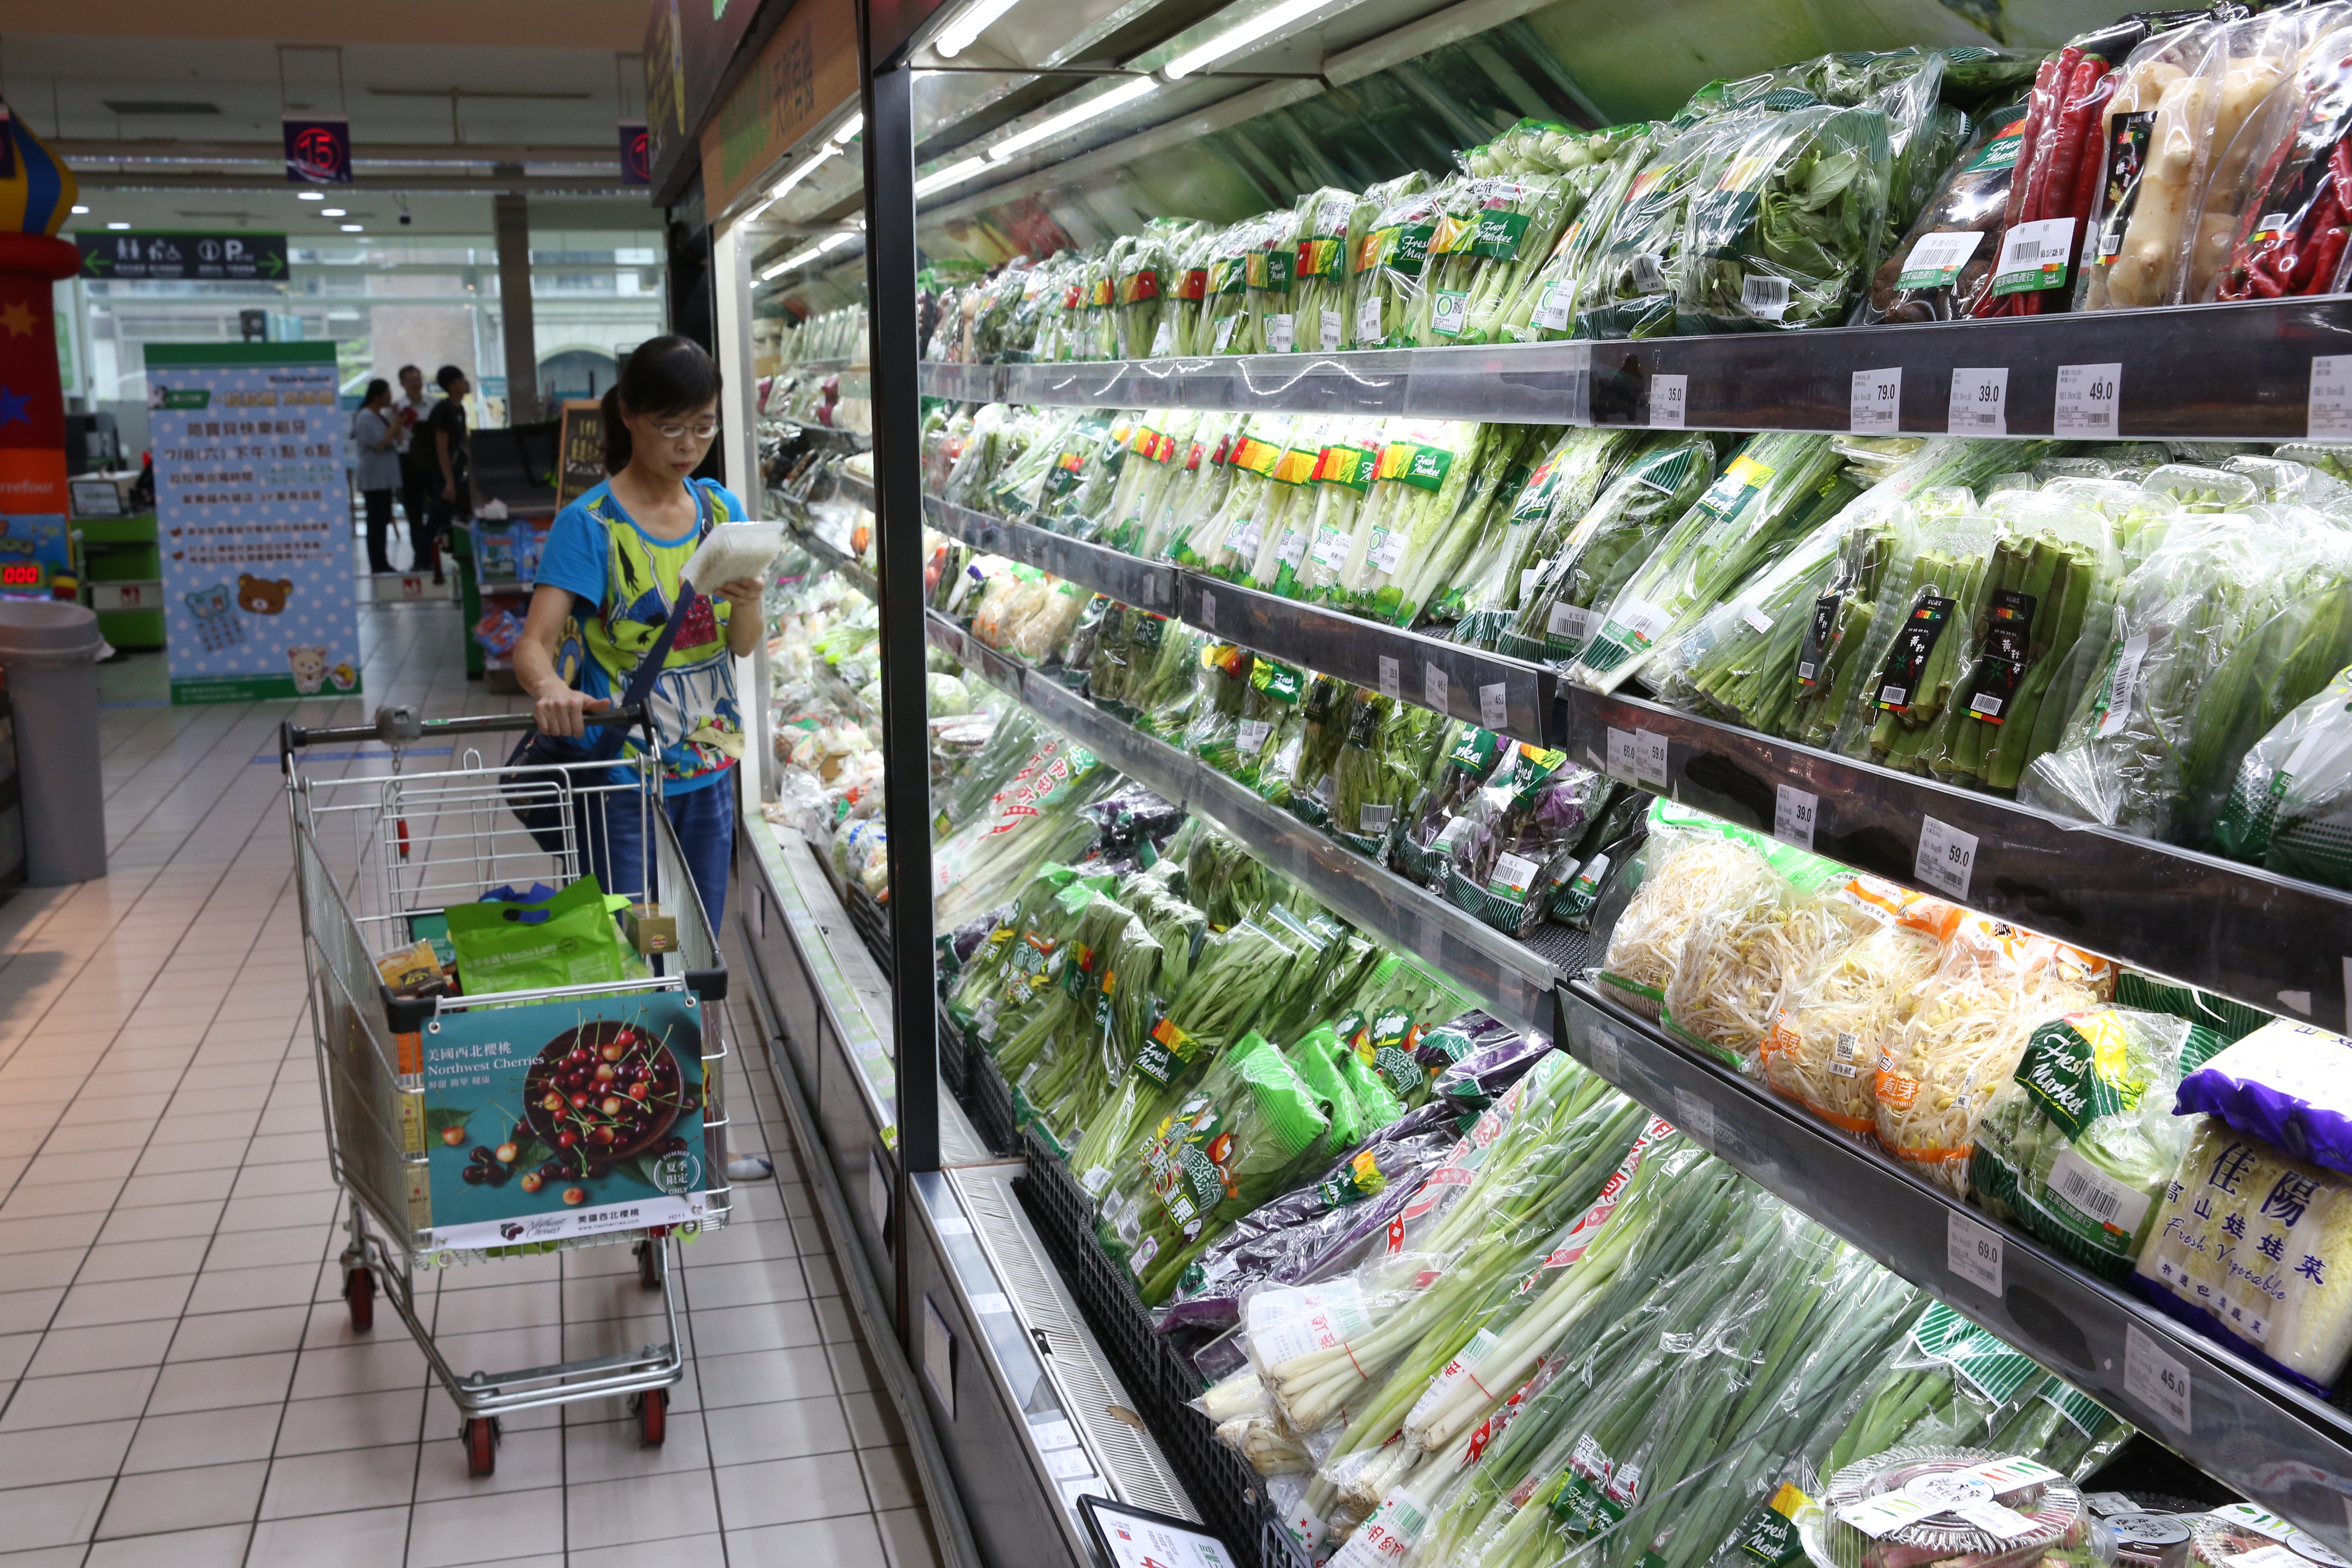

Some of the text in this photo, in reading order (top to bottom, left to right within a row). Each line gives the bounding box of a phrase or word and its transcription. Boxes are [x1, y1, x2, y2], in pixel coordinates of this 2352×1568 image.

[299, 136, 334, 168] 15
[1668, 388, 1682, 401] 35.0
[1878, 384, 1895, 400] 79.0
[1979, 385, 1999, 402] 39.0
[2089, 381, 2112, 400] 49.0
[1414, 454, 1436, 468] Fresh
[1412, 465, 1441, 477] Market
[2002, 639, 2021, 674] 黃秋葵
[1495, 694, 1503, 706] 45.0
[1624, 744, 1635, 759] 69.0
[1652, 746, 1664, 761] 59.0
[1797, 804, 1812, 822] 39.0
[1949, 844, 1969, 867] 59.0
[428, 1041, 512, 1062] 美國西北櫻桃
[1139, 1040, 1171, 1064] Fresh
[2036, 1033, 2095, 1080] Fresh
[428, 1056, 544, 1076] Northwest Cherries
[1832, 1063, 1852, 1075] 須冷藏
[2027, 1062, 2088, 1115] Market
[662, 1150, 690, 1161] SUMMER
[666, 1160, 688, 1173] 夏季
[666, 1173, 688, 1186] 限定
[2207, 1139, 2321, 1227] 佳陽
[668, 1187, 688, 1196] ONLY
[577, 1208, 640, 1224] 美國西北櫻桃
[2045, 1188, 2094, 1229] 旺家福農產行
[2103, 1231, 2118, 1242] Fresh
[2165, 1180, 2327, 1285] 高山娃娃菜
[1978, 1240, 1998, 1263] 69.0
[2164, 1215, 2287, 1301] Fresh Vegetable
[2160, 1368, 2185, 1398] 45.0
[1751, 1512, 1790, 1541] Fresh
[1743, 1532, 1785, 1558] Mark
